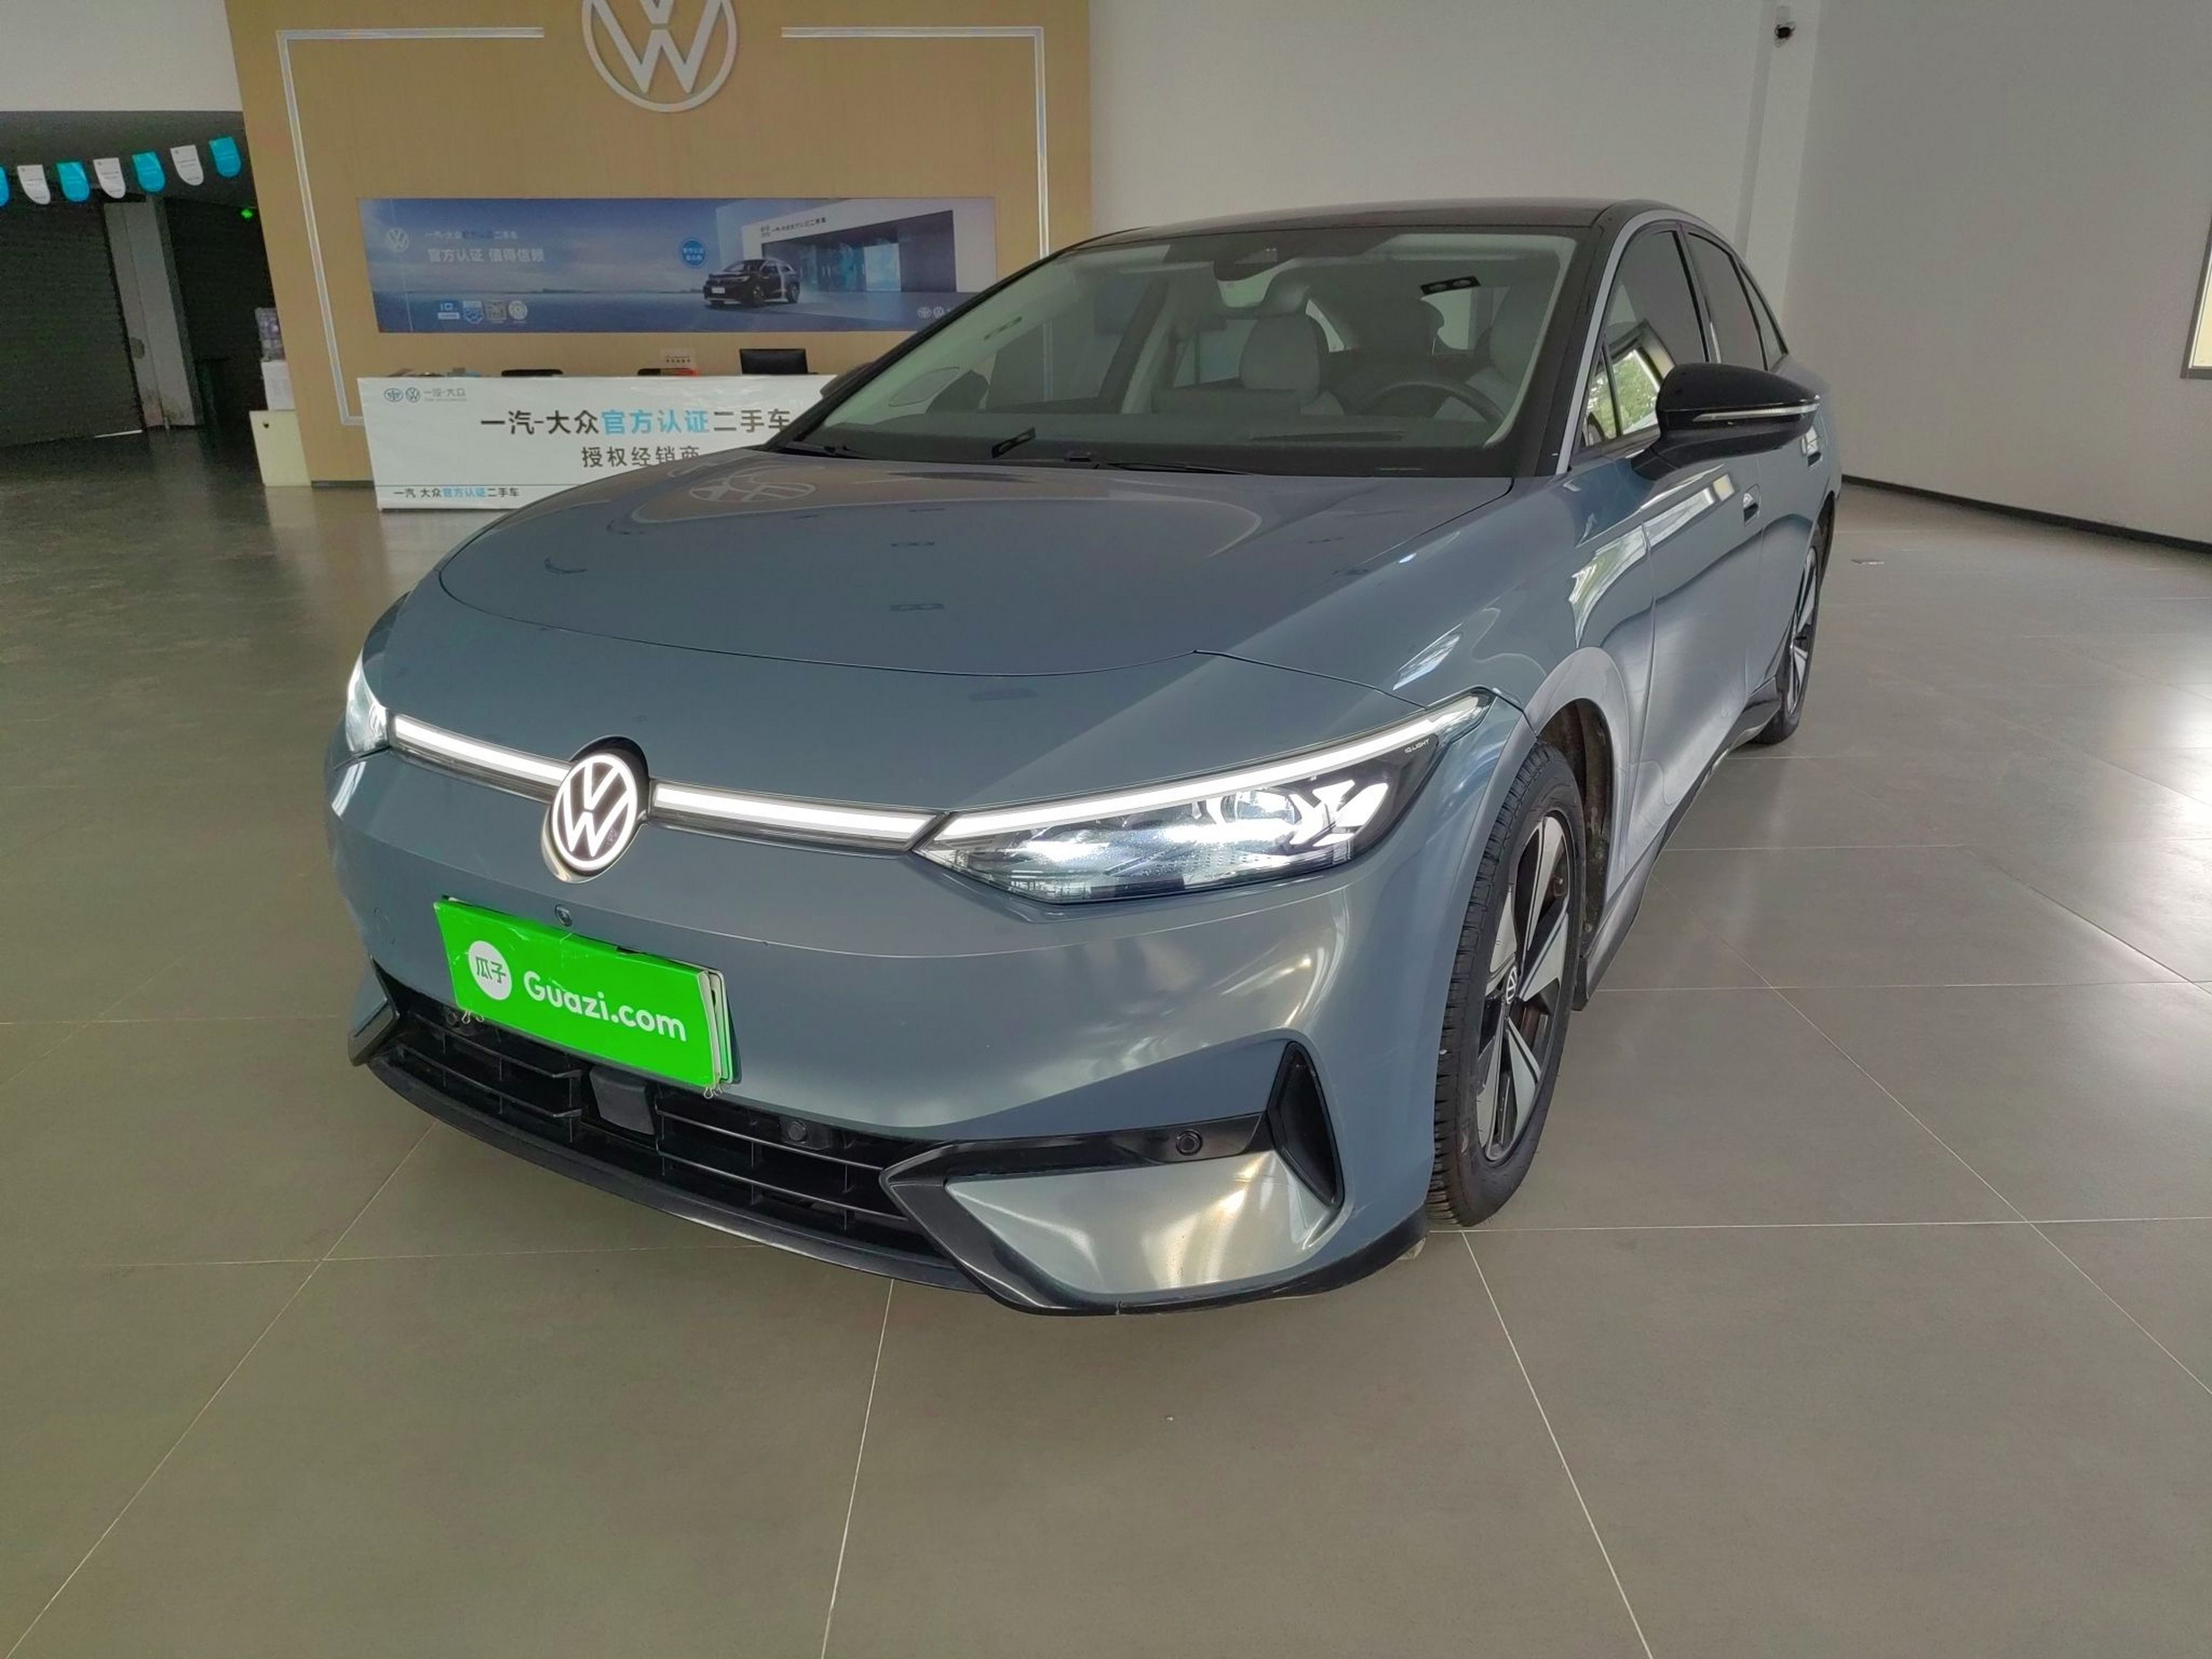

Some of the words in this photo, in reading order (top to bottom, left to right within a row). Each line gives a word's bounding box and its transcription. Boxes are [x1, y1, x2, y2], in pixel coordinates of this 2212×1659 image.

[427, 249, 484, 262] 官方认证
[480, 408, 790, 435] 一汽-大众官方认证二手车
[475, 955, 507, 984] 瓜子
[523, 970, 688, 1043] Guazi.com
